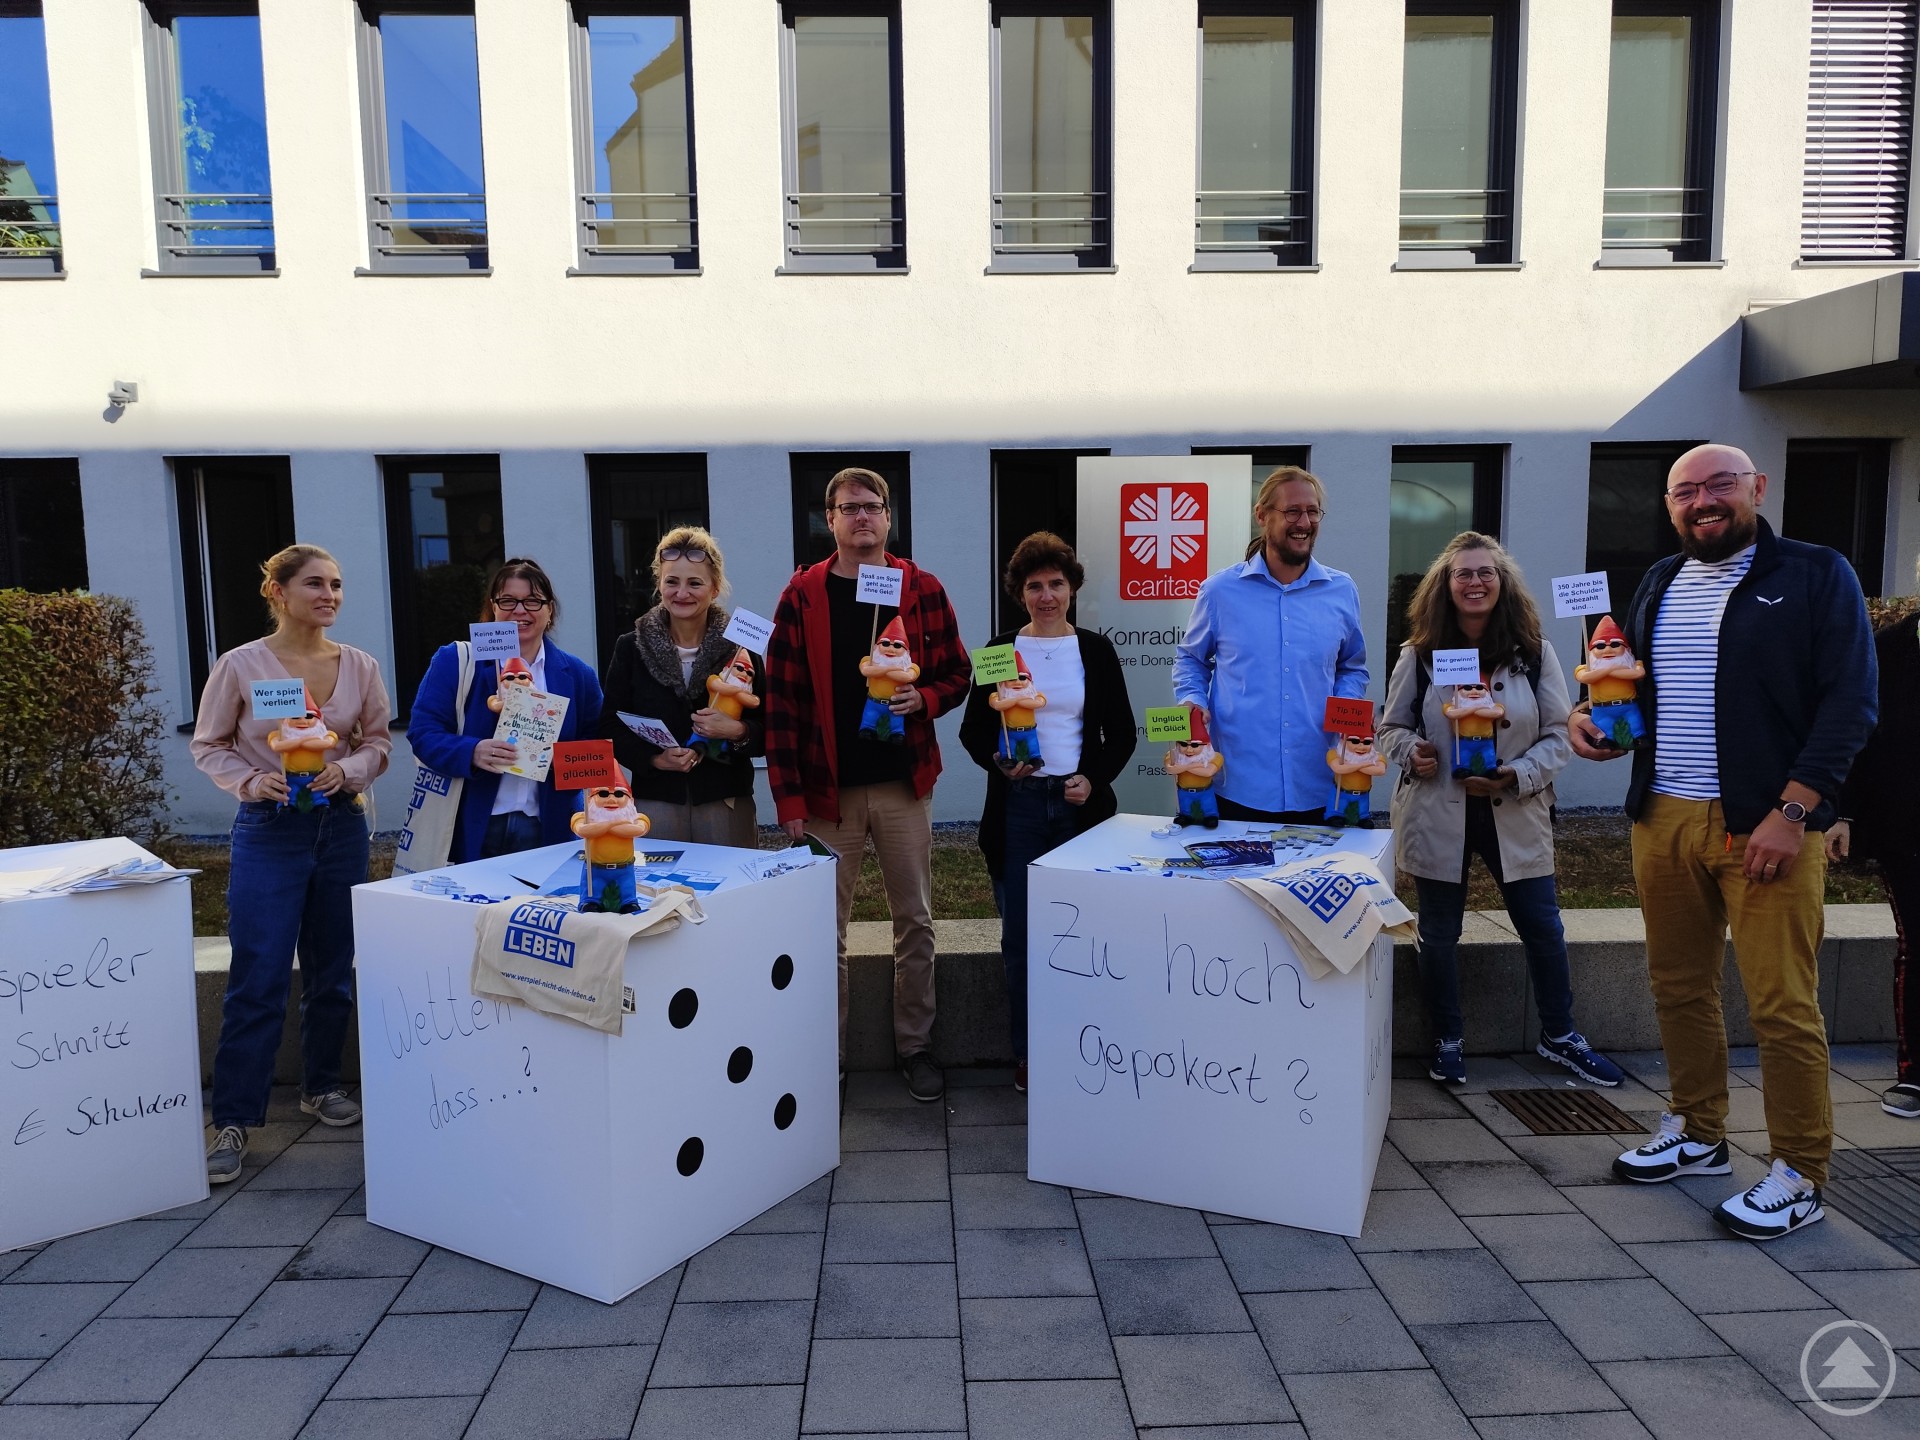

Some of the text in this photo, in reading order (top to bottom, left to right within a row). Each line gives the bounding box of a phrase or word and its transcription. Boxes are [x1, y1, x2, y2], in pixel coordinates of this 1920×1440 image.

[886, 575, 901, 583] Spiel
[1126, 573, 1201, 597] caritas
[1571, 581, 1591, 589] Jahre
[1570, 587, 1604, 596] Schulden
[1565, 595, 1599, 605] abbezahlt
[733, 616, 770, 637] Automatisch
[736, 626, 760, 641] verloren
[476, 644, 516, 653] Glücksspiel
[981, 652, 1007, 662] Verspiel
[1141, 654, 1176, 667] Dona
[1449, 656, 1476, 664] gewinnt?
[976, 659, 1015, 671] nicht meinen
[986, 667, 1007, 676] Garten
[253, 687, 303, 698] Wer spielt
[262, 698, 297, 707] verliert
[1336, 706, 1363, 717] Tip Tip
[1151, 714, 1185, 724] Unglück
[1331, 717, 1365, 728] Verzockt
[1163, 724, 1187, 732] Glück
[564, 753, 605, 764] Spiellos
[562, 768, 608, 781] glücklich
[1137, 764, 1173, 776] Pass
[414, 770, 446, 794] SPIEL
[514, 904, 563, 932] DEIN
[507, 929, 572, 965] LEBEN
[1048, 900, 1127, 981] Zu
[1162, 912, 1315, 1009] hoch
[500, 970, 596, 1003] www.verspiel-nicht-dein-leben.de
[381, 965, 512, 1060] Wetten
[10, 1020, 131, 1070] Schnitt
[1074, 1023, 1268, 1104] gepokert
[66, 1093, 189, 1136] Schulden
